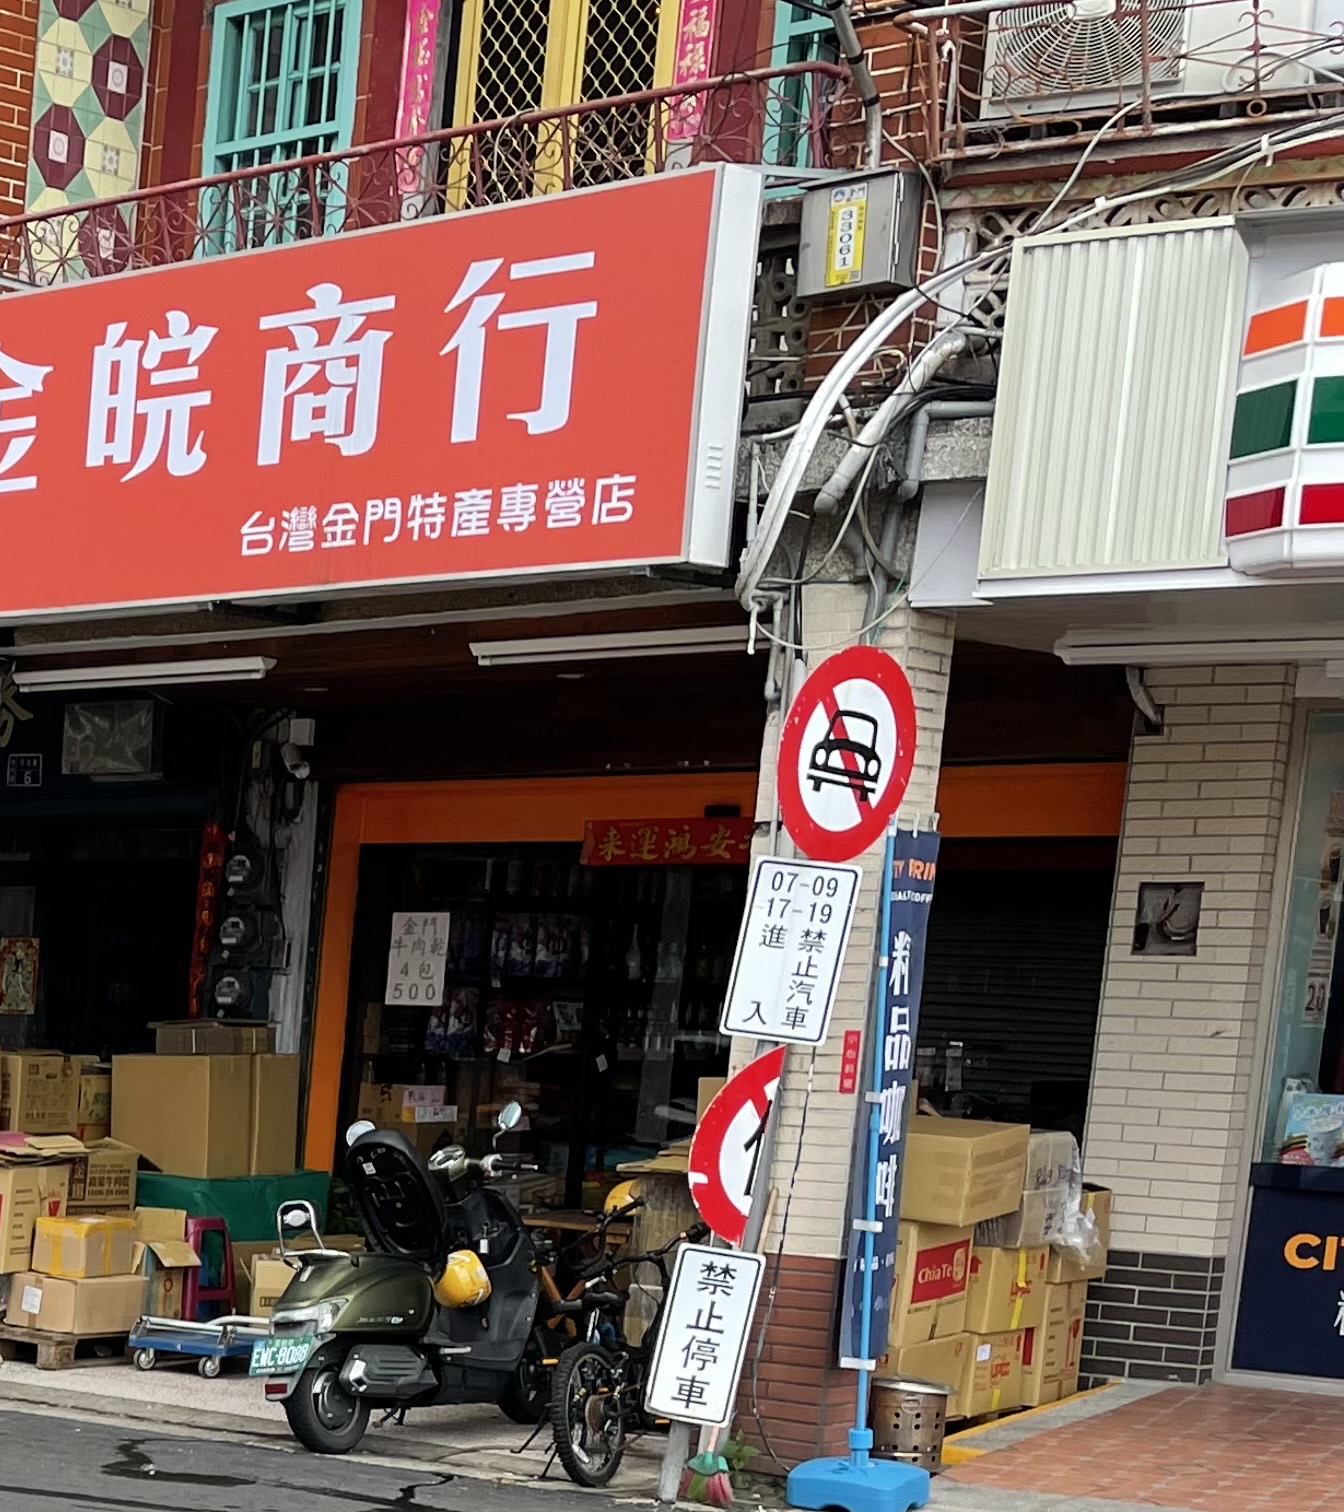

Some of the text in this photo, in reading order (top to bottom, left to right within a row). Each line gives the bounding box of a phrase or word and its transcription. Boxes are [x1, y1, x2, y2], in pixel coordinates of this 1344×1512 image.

[839, 209, 853, 267] 33061
[239, 473, 638, 557] 台灣金門特產專營店
[766, 897, 833, 924] 17-19
[771, 870, 839, 898] 07-09
[393, 982, 436, 1001] 500
[742, 923, 789, 1025] 進入
[781, 928, 828, 1030] 禁止汽車
[1283, 1233, 1344, 1271] CI
[670, 1260, 738, 1409] 禁止停車
